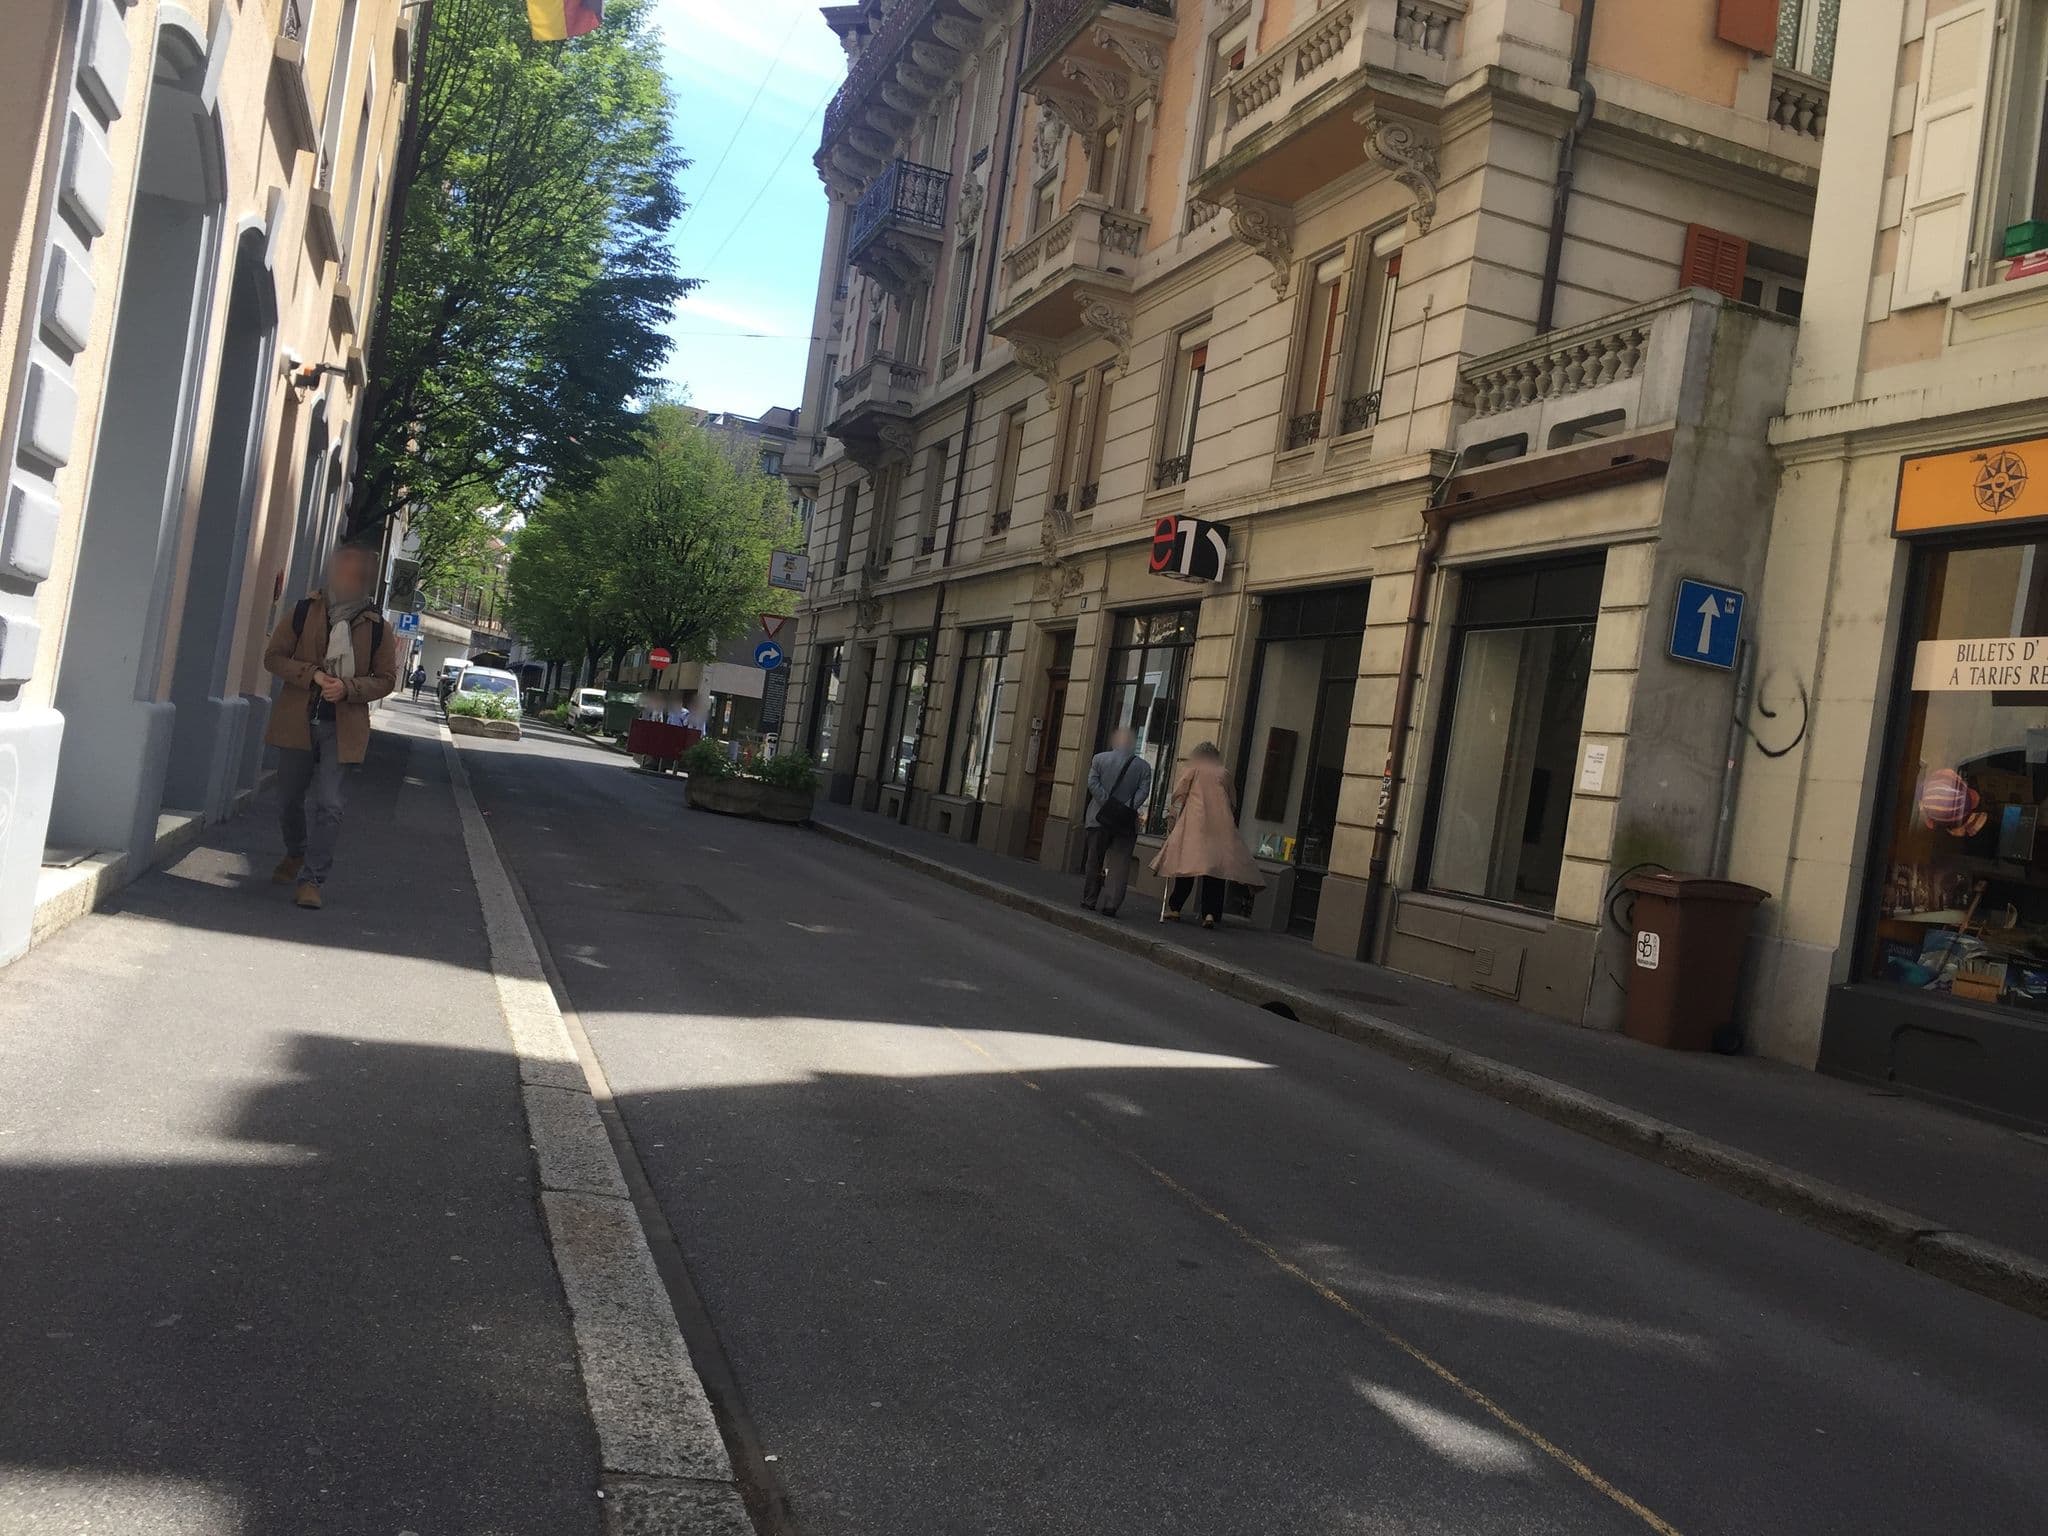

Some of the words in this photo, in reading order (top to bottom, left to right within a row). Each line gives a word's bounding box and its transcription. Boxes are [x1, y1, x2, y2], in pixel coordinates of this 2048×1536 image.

[401, 614, 413, 628] P
[1956, 642, 2016, 663] BILLETS
[2022, 639, 2040, 661] D'
[1949, 667, 1959, 686] A
[1969, 665, 2022, 686] TARIFS
